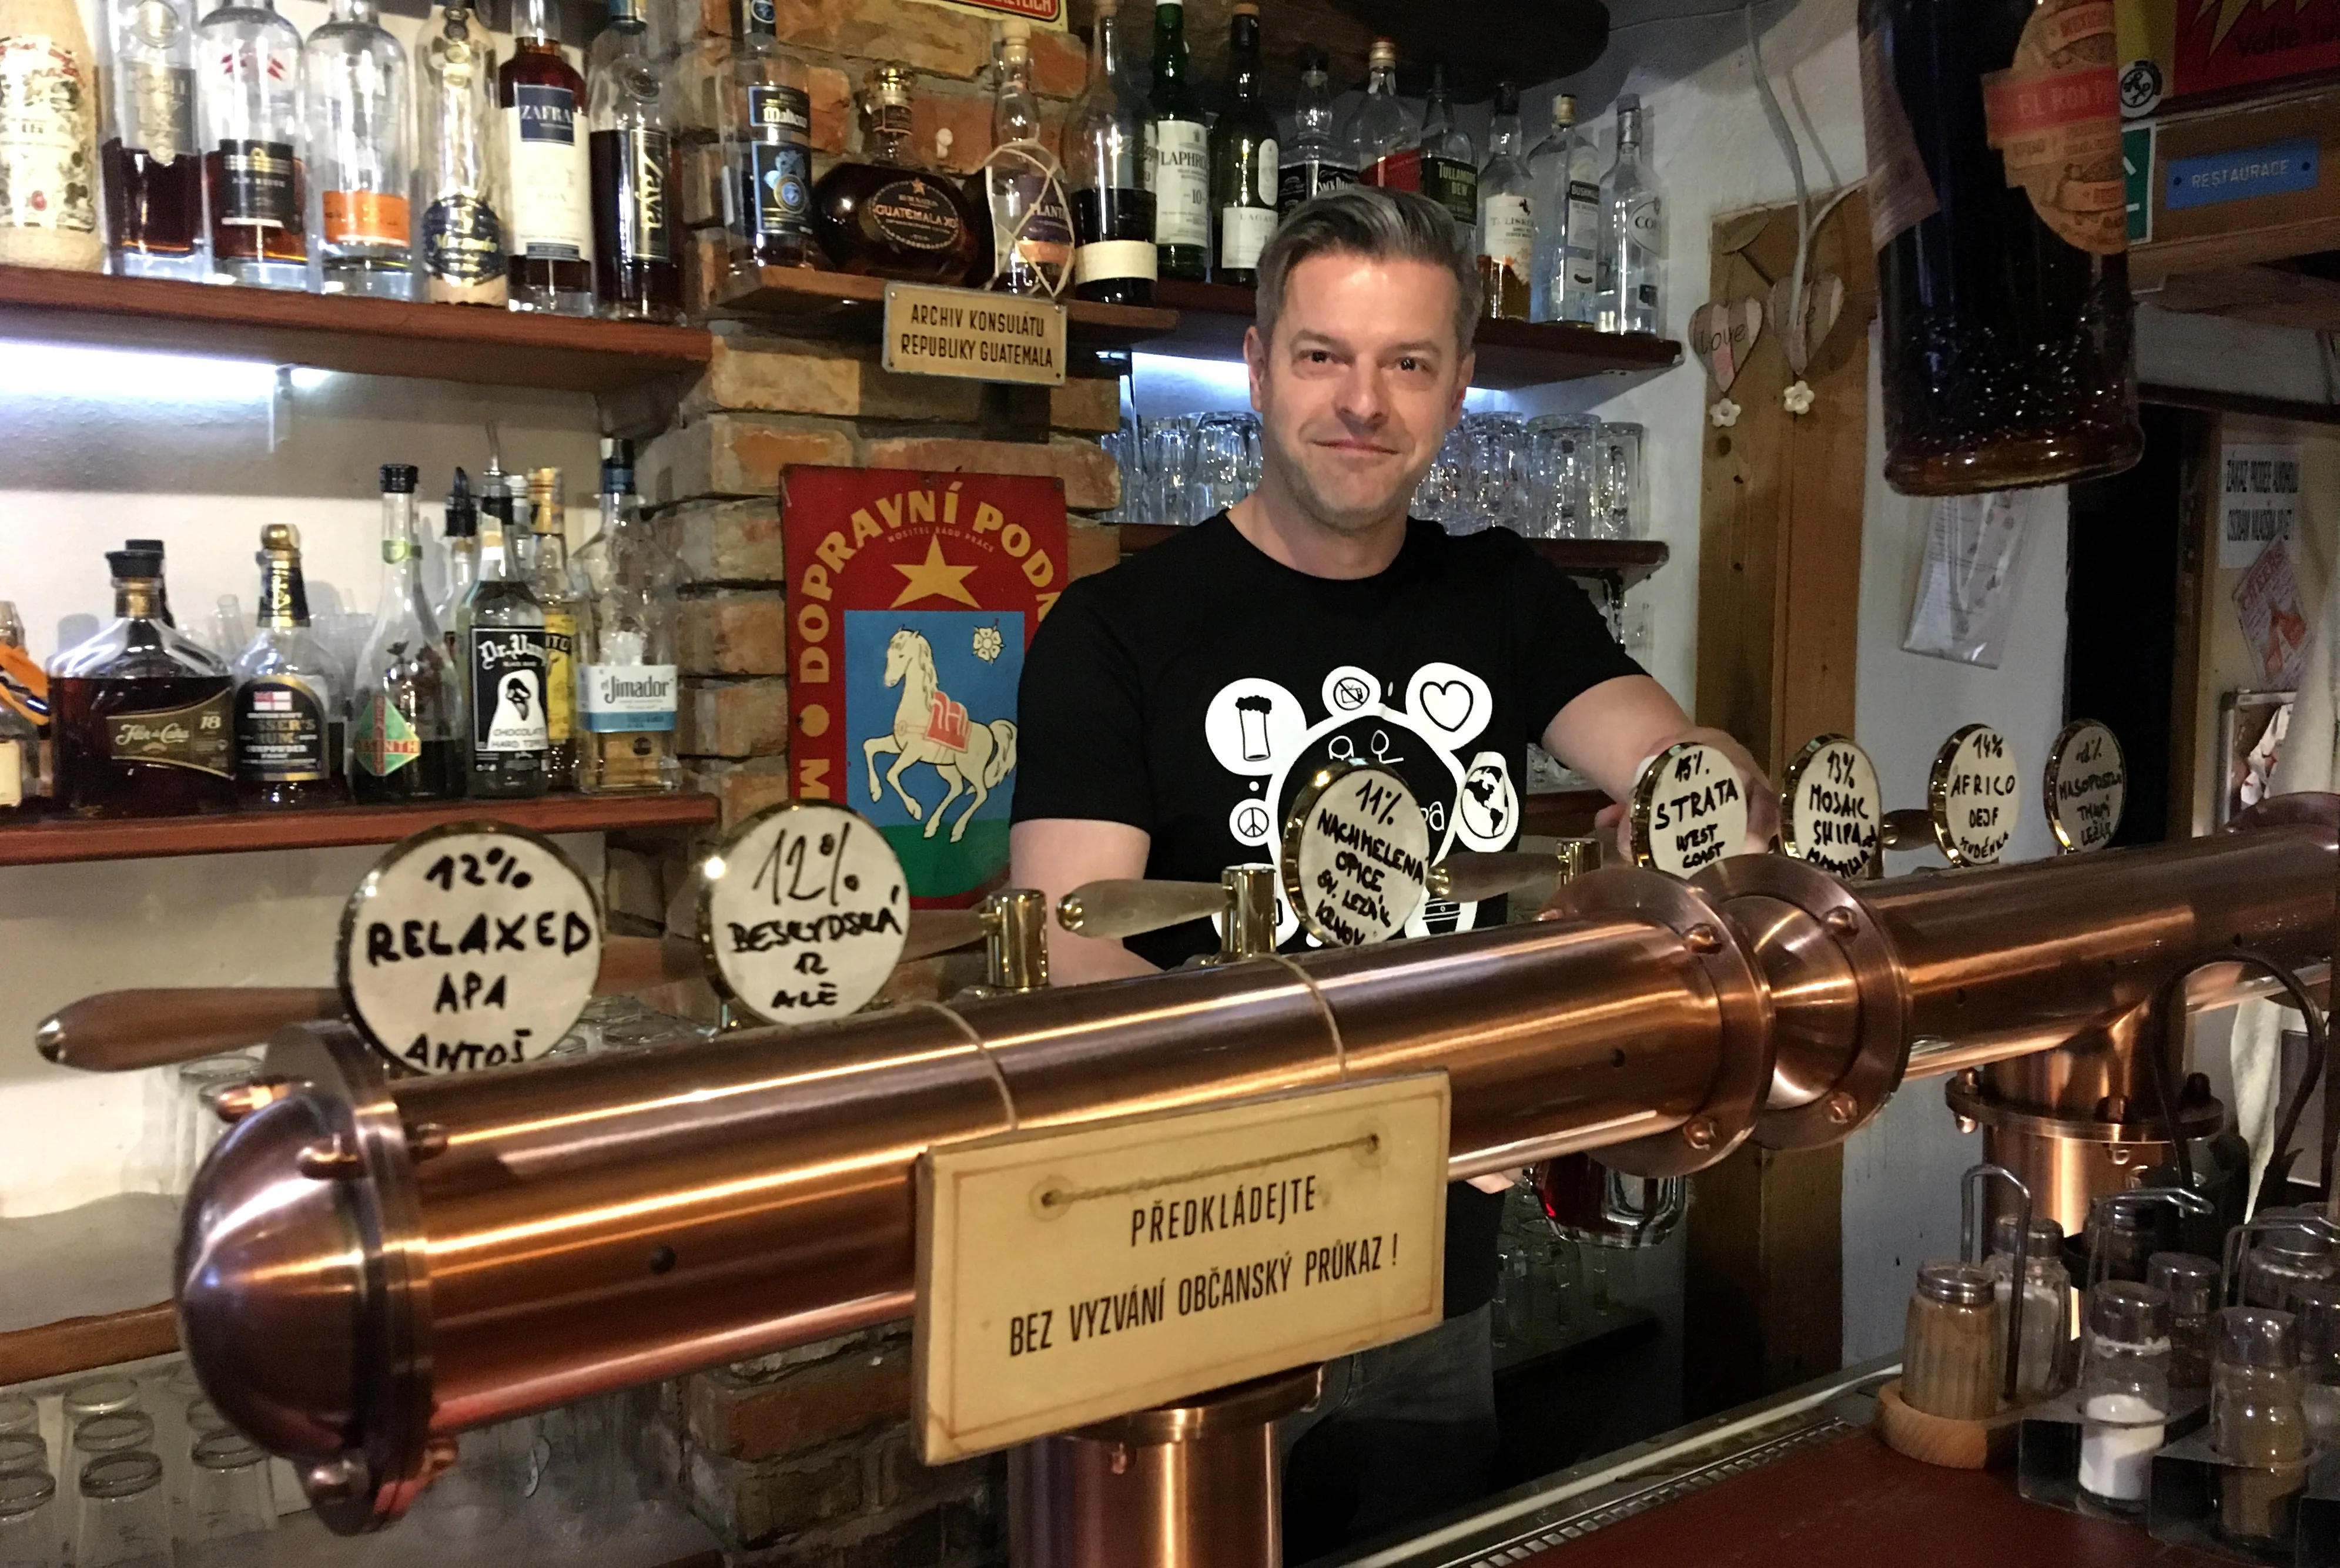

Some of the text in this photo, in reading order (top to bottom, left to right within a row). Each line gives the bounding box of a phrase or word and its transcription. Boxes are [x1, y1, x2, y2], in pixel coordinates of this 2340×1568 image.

[2192, 159, 2290, 189] RESTAURACE
[911, 303, 1045, 337] ARCHIV KONSULÁTU
[901, 333, 1053, 368] REPUBLIKY GUATEMALA
[798, 481, 963, 683] DOPRAVNÍ
[604, 675, 669, 704] Jimador
[200, 716, 221, 729] 18
[1973, 733, 2004, 759] 14%
[1355, 778, 1402, 825] 11%
[1655, 778, 1739, 830] STRATA
[1809, 783, 1869, 820] MOSAIC
[1950, 774, 2016, 798] AFRICO
[1676, 823, 1718, 852] WEST
[1682, 841, 1725, 869] COAST
[423, 847, 533, 892] 12%
[751, 822, 860, 906] 12%
[366, 911, 591, 967] RELAXED
[433, 971, 507, 1015] APA
[1130, 1174, 1317, 1248] PŘEDKLÁDEJTE
[1008, 1309, 1053, 1357] BEZ
[1069, 1277, 1167, 1342] VYZVÁNÍ
[1177, 1250, 1293, 1317] OBČANSKÝ
[1304, 1237, 1384, 1287] PRŮKAZ
